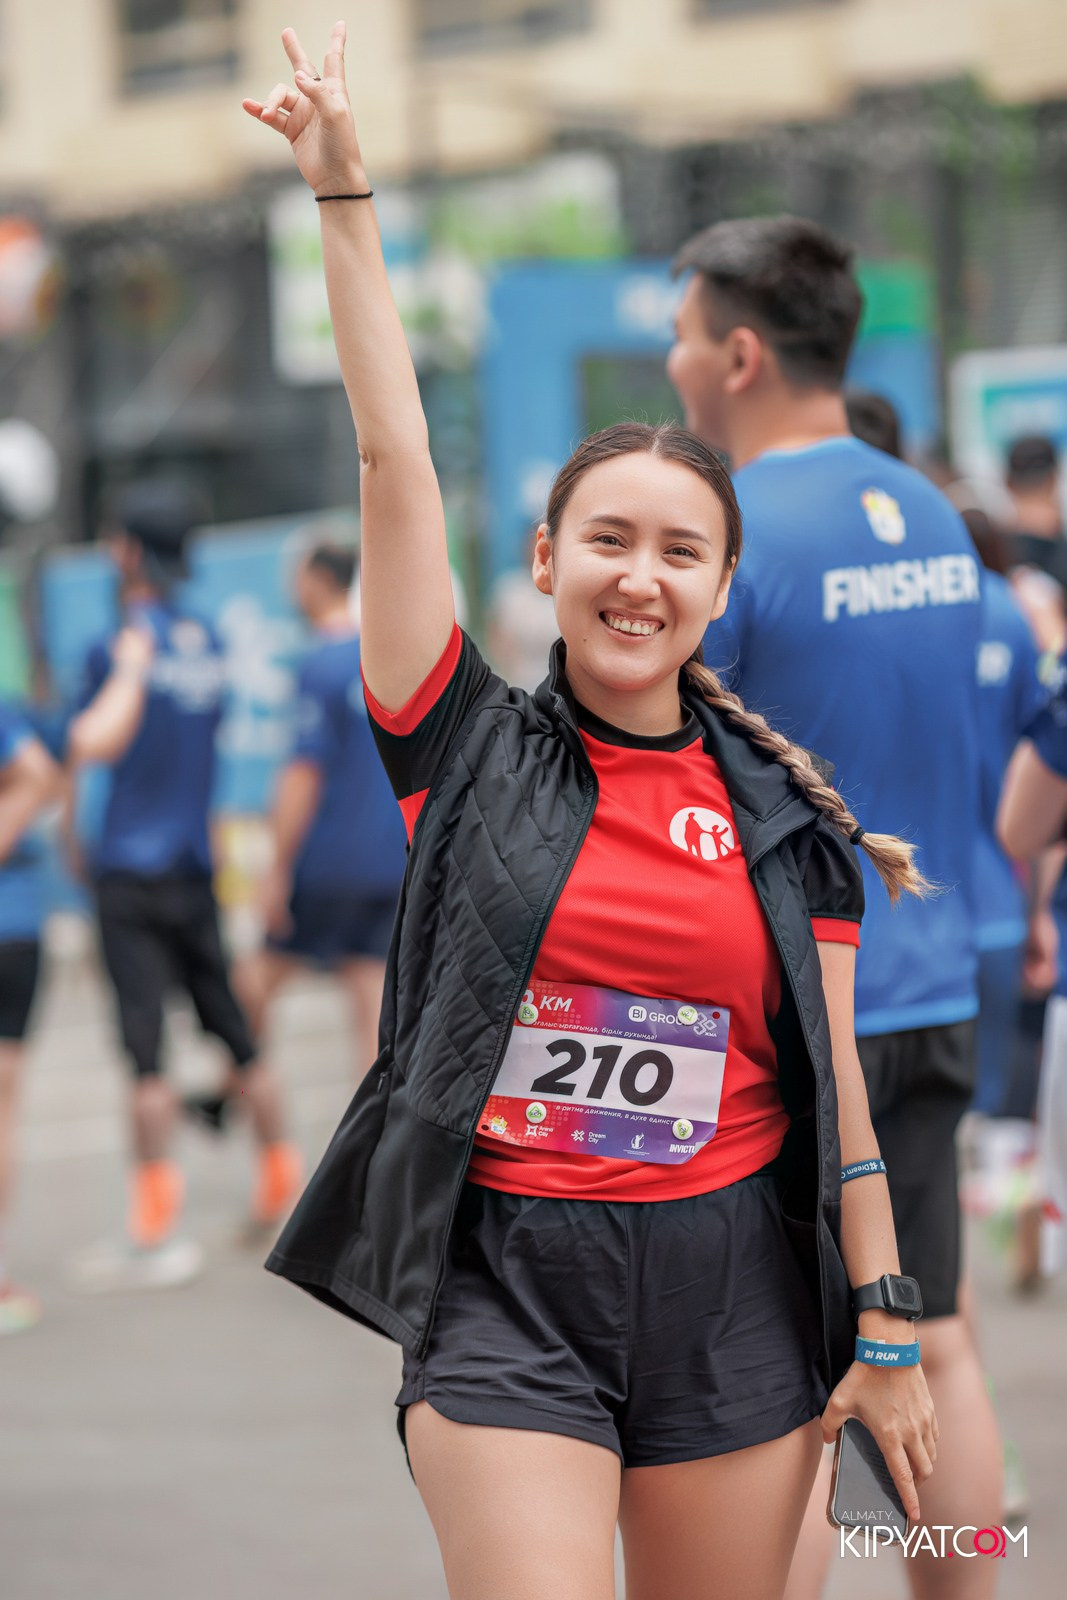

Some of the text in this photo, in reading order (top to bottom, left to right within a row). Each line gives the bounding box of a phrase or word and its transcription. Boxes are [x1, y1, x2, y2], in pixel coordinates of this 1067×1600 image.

[823, 554, 980, 622] FINISHER
[540, 996, 573, 1012] KM
[632, 1009, 682, 1025] BI GROU
[530, 1039, 674, 1106] 210
[649, 1118, 674, 1126] единст
[588, 1137, 599, 1145] City
[864, 1349, 875, 1359] BI
[875, 1351, 899, 1361] RUN
